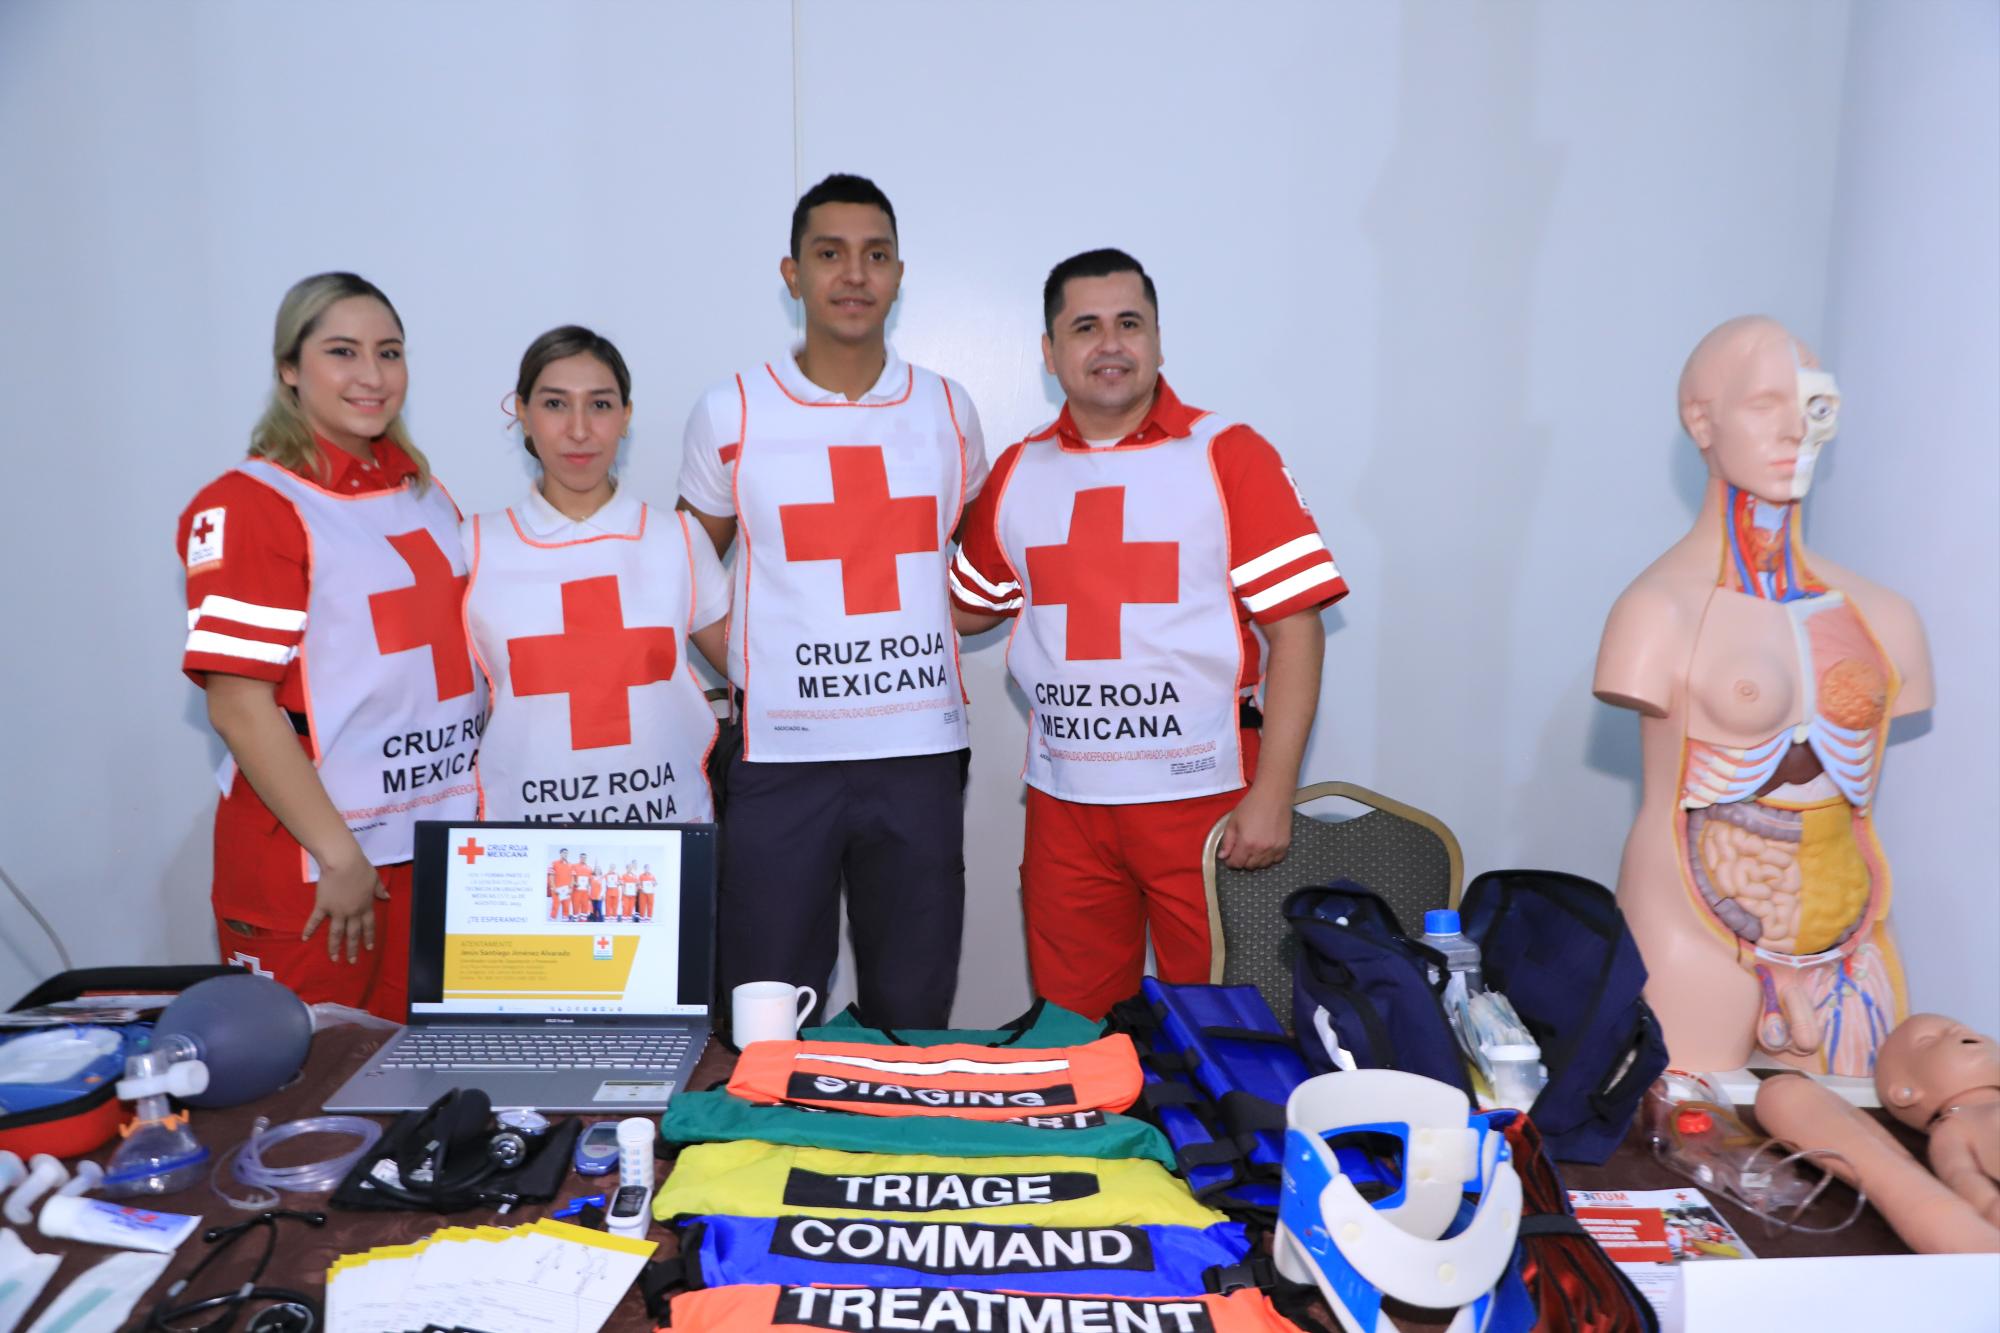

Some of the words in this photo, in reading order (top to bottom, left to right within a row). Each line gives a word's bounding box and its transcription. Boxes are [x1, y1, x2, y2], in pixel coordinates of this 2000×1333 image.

[796, 640, 872, 666] CRUZ
[881, 632, 945, 660] ROJA
[799, 664, 947, 699] MEXICANA
[1035, 683, 1092, 707] CRUZ
[1100, 681, 1180, 707] ROJA
[383, 724, 457, 758] CRUZ
[1041, 714, 1183, 740] MEXICANA
[522, 775, 599, 803] CRUZ
[609, 762, 675, 795] ROJA
[813, 1075, 1047, 1106] STAGING
[836, 1173, 1052, 1208] TRIAGE
[790, 1219, 1133, 1269] COMMAND
[787, 1286, 1203, 1333] TREATMENT
